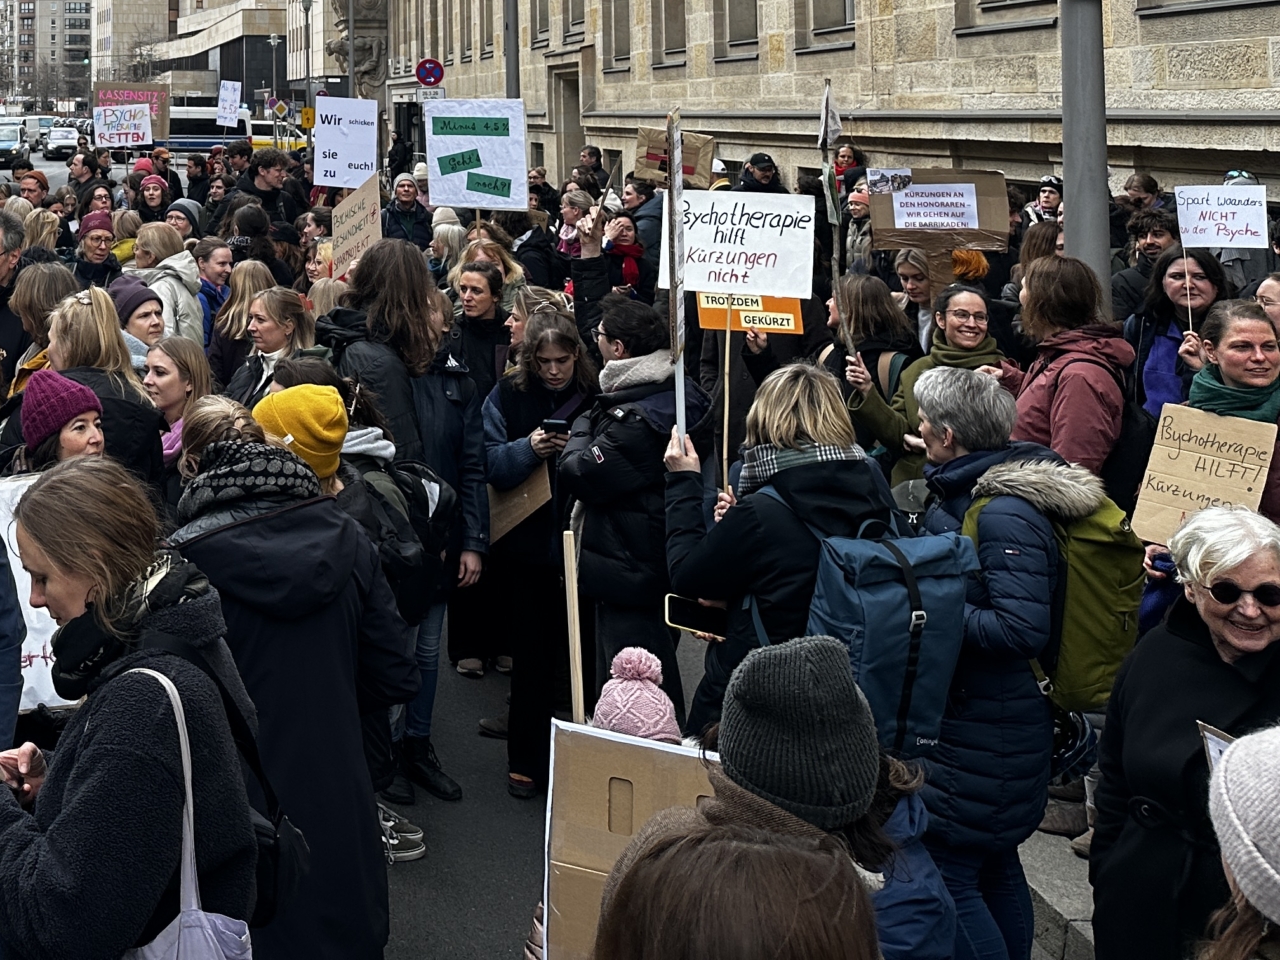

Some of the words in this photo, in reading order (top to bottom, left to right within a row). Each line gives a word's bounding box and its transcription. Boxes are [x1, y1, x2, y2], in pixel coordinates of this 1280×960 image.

[103, 122, 142, 132] THERAPIE
[319, 113, 343, 126] Wir
[348, 118, 375, 127] schicken
[440, 120, 476, 131] Minus
[98, 132, 145, 145] RETTEN
[322, 149, 338, 159] sie
[323, 169, 336, 178] zu
[347, 161, 374, 172] euch!
[475, 178, 511, 192] noch?!
[904, 190, 952, 198] KÜRZUNGEN
[1177, 190, 1212, 211] Spart
[916, 200, 966, 208] HONORAREN
[1198, 210, 1238, 222] NICHT
[332, 213, 369, 252] GESUNDHEIT
[713, 225, 746, 246] hilft
[1192, 224, 1208, 235] der
[1214, 222, 1262, 243] Psyche
[333, 234, 371, 272] SPARPROJEKT
[707, 268, 750, 284] nicht
[704, 295, 760, 308] TROTZDEM
[743, 314, 792, 328] GEKÜRZT
[1160, 415, 1269, 464] Psychotherapie
[1194, 456, 1263, 493] HILFT!
[1144, 473, 1234, 511] Kürzungen
